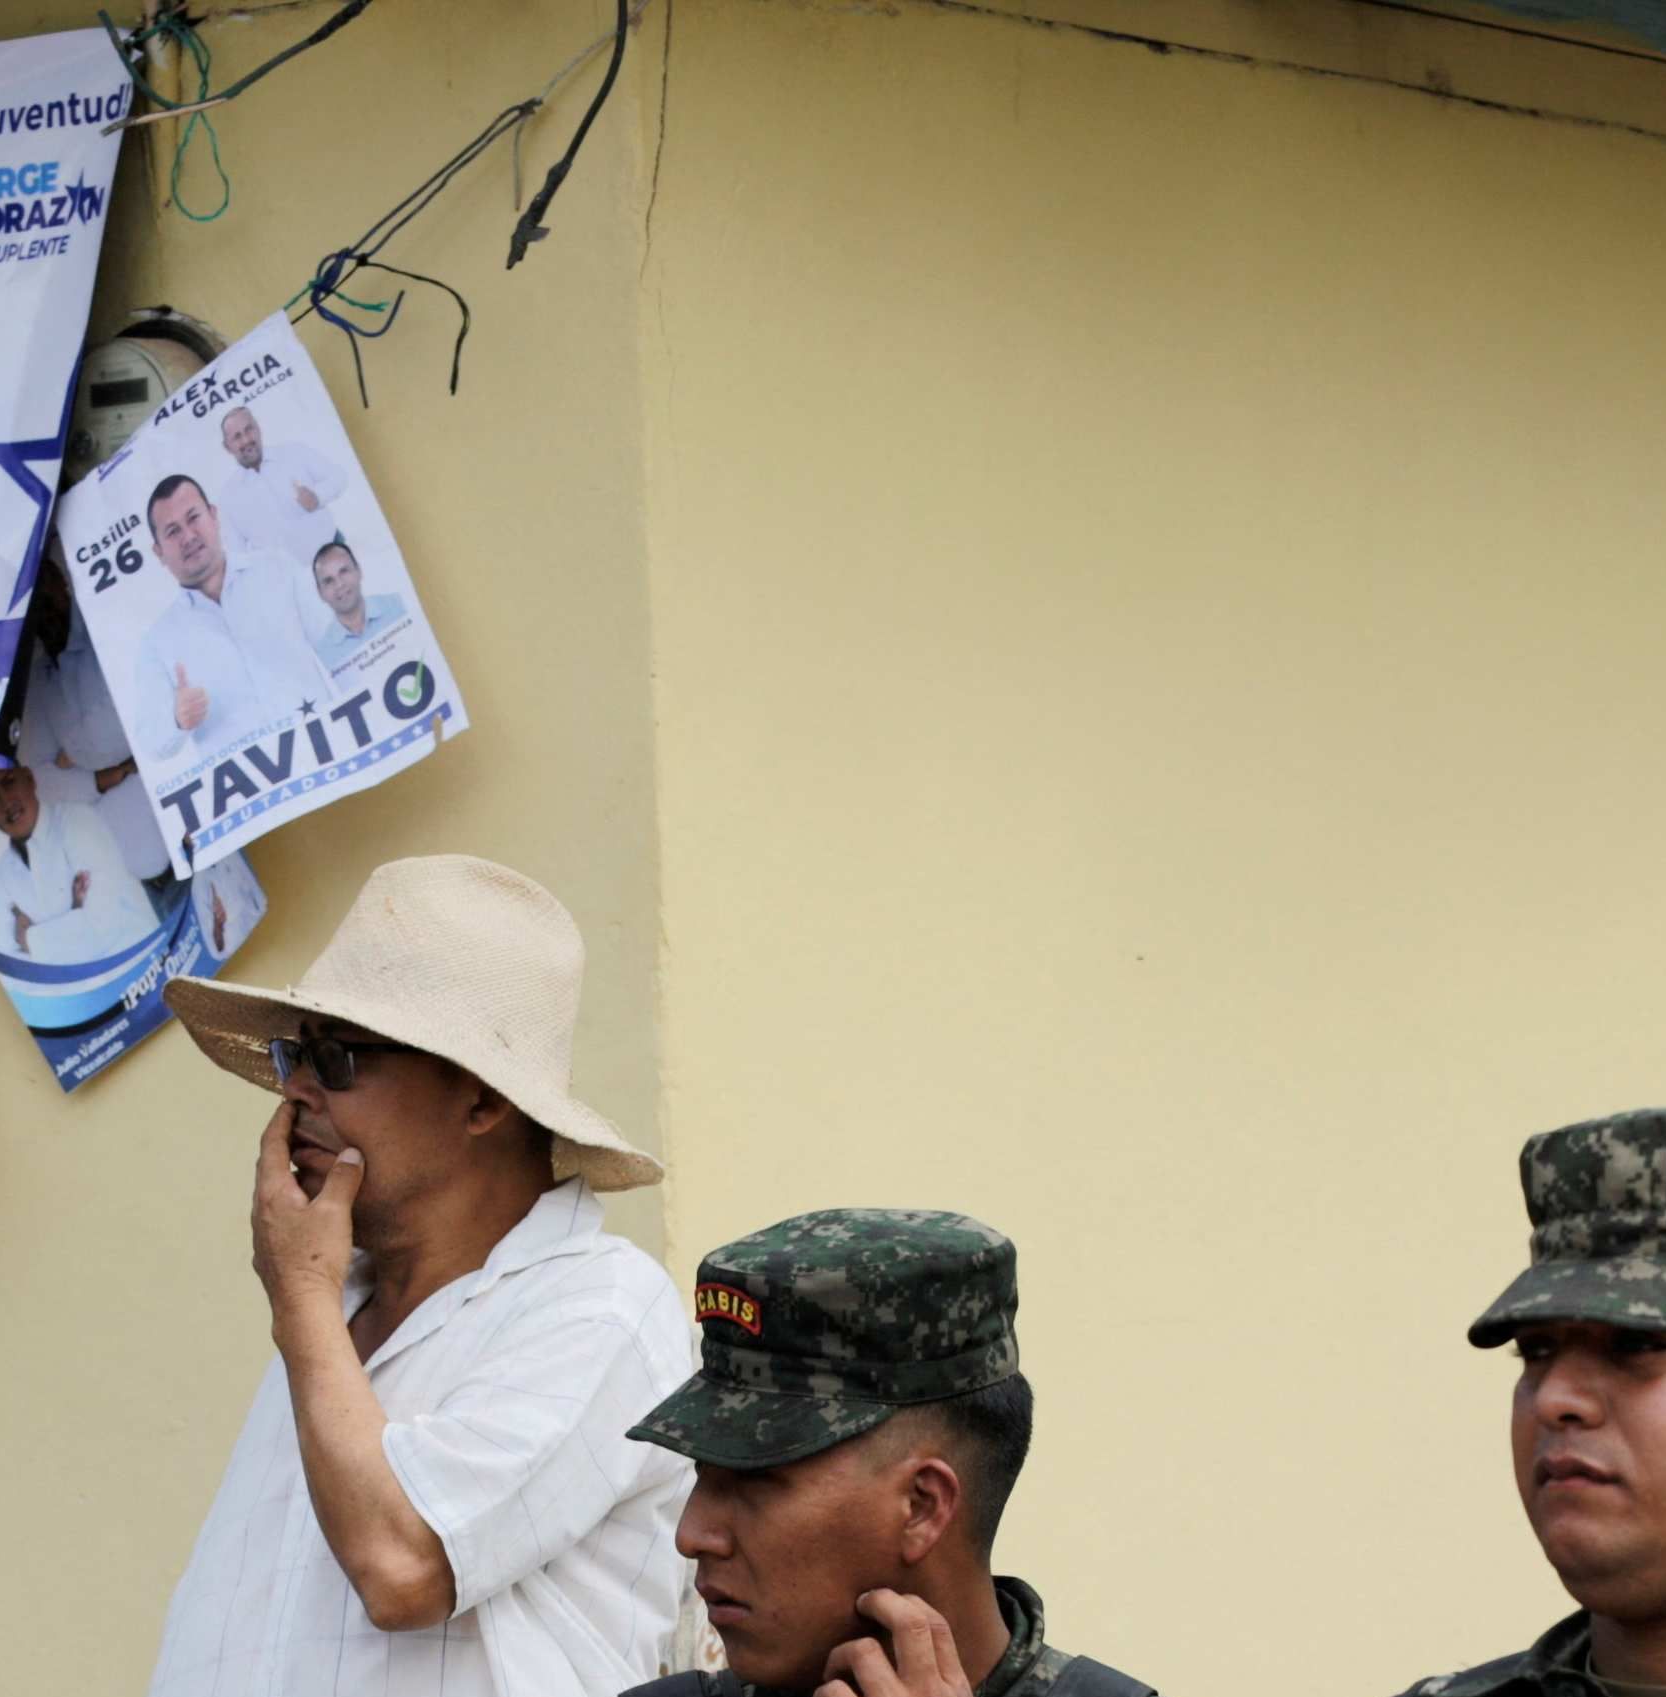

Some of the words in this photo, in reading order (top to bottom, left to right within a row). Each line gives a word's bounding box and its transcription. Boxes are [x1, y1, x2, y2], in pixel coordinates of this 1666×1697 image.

[153, 369, 220, 427] ALEX
[191, 353, 282, 419] GARCIA
[75, 513, 142, 564] Casilla
[88, 538, 144, 595] 26
[696, 1289, 755, 1323] CABIS
